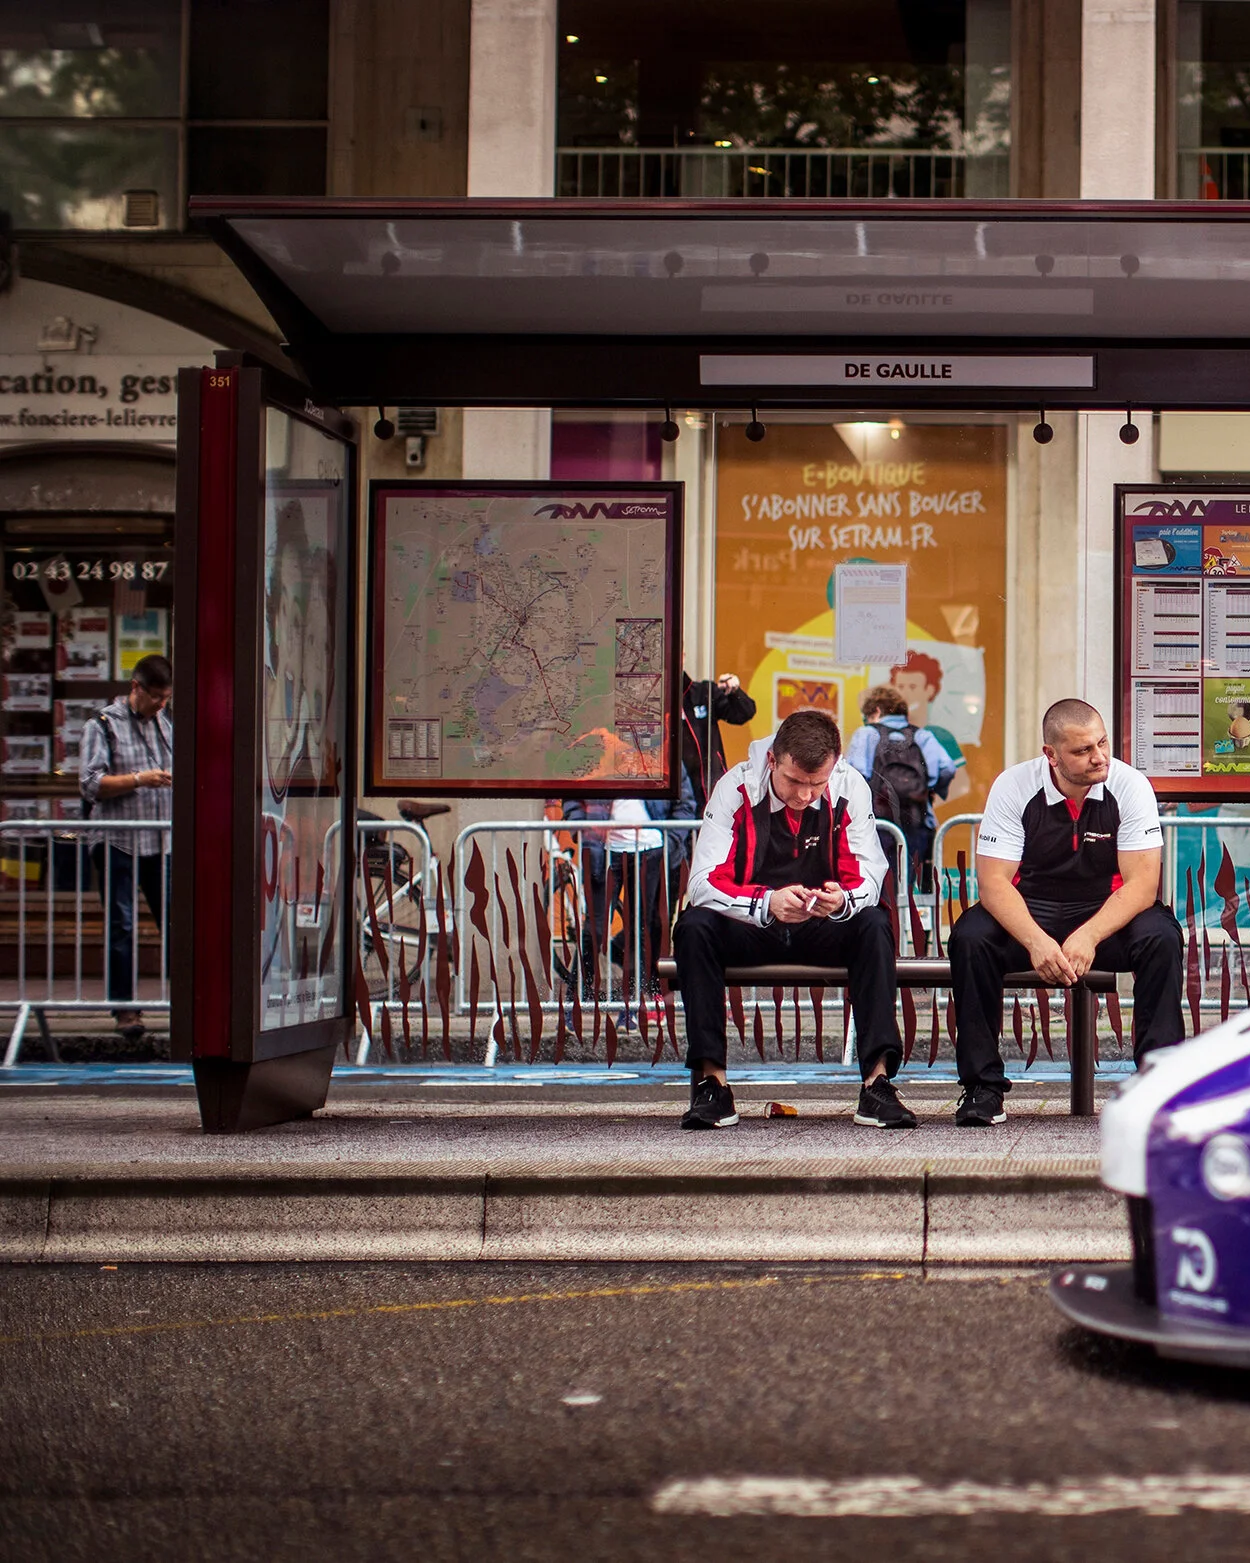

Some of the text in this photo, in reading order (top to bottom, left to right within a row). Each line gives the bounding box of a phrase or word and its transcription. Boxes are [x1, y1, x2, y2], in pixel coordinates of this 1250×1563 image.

[209, 376, 230, 387] 351
[845, 363, 952, 379] DE GAULLE
[120, 374, 178, 403] ges
[803, 460, 926, 488] E-BOUTIQUE
[741, 490, 986, 522] S'ABONNER SANS BOUGER
[1235, 504, 1247, 513] LE
[789, 522, 938, 550] SUR SETRAM.FR
[12, 560, 170, 580] 02 43 24 98 87
